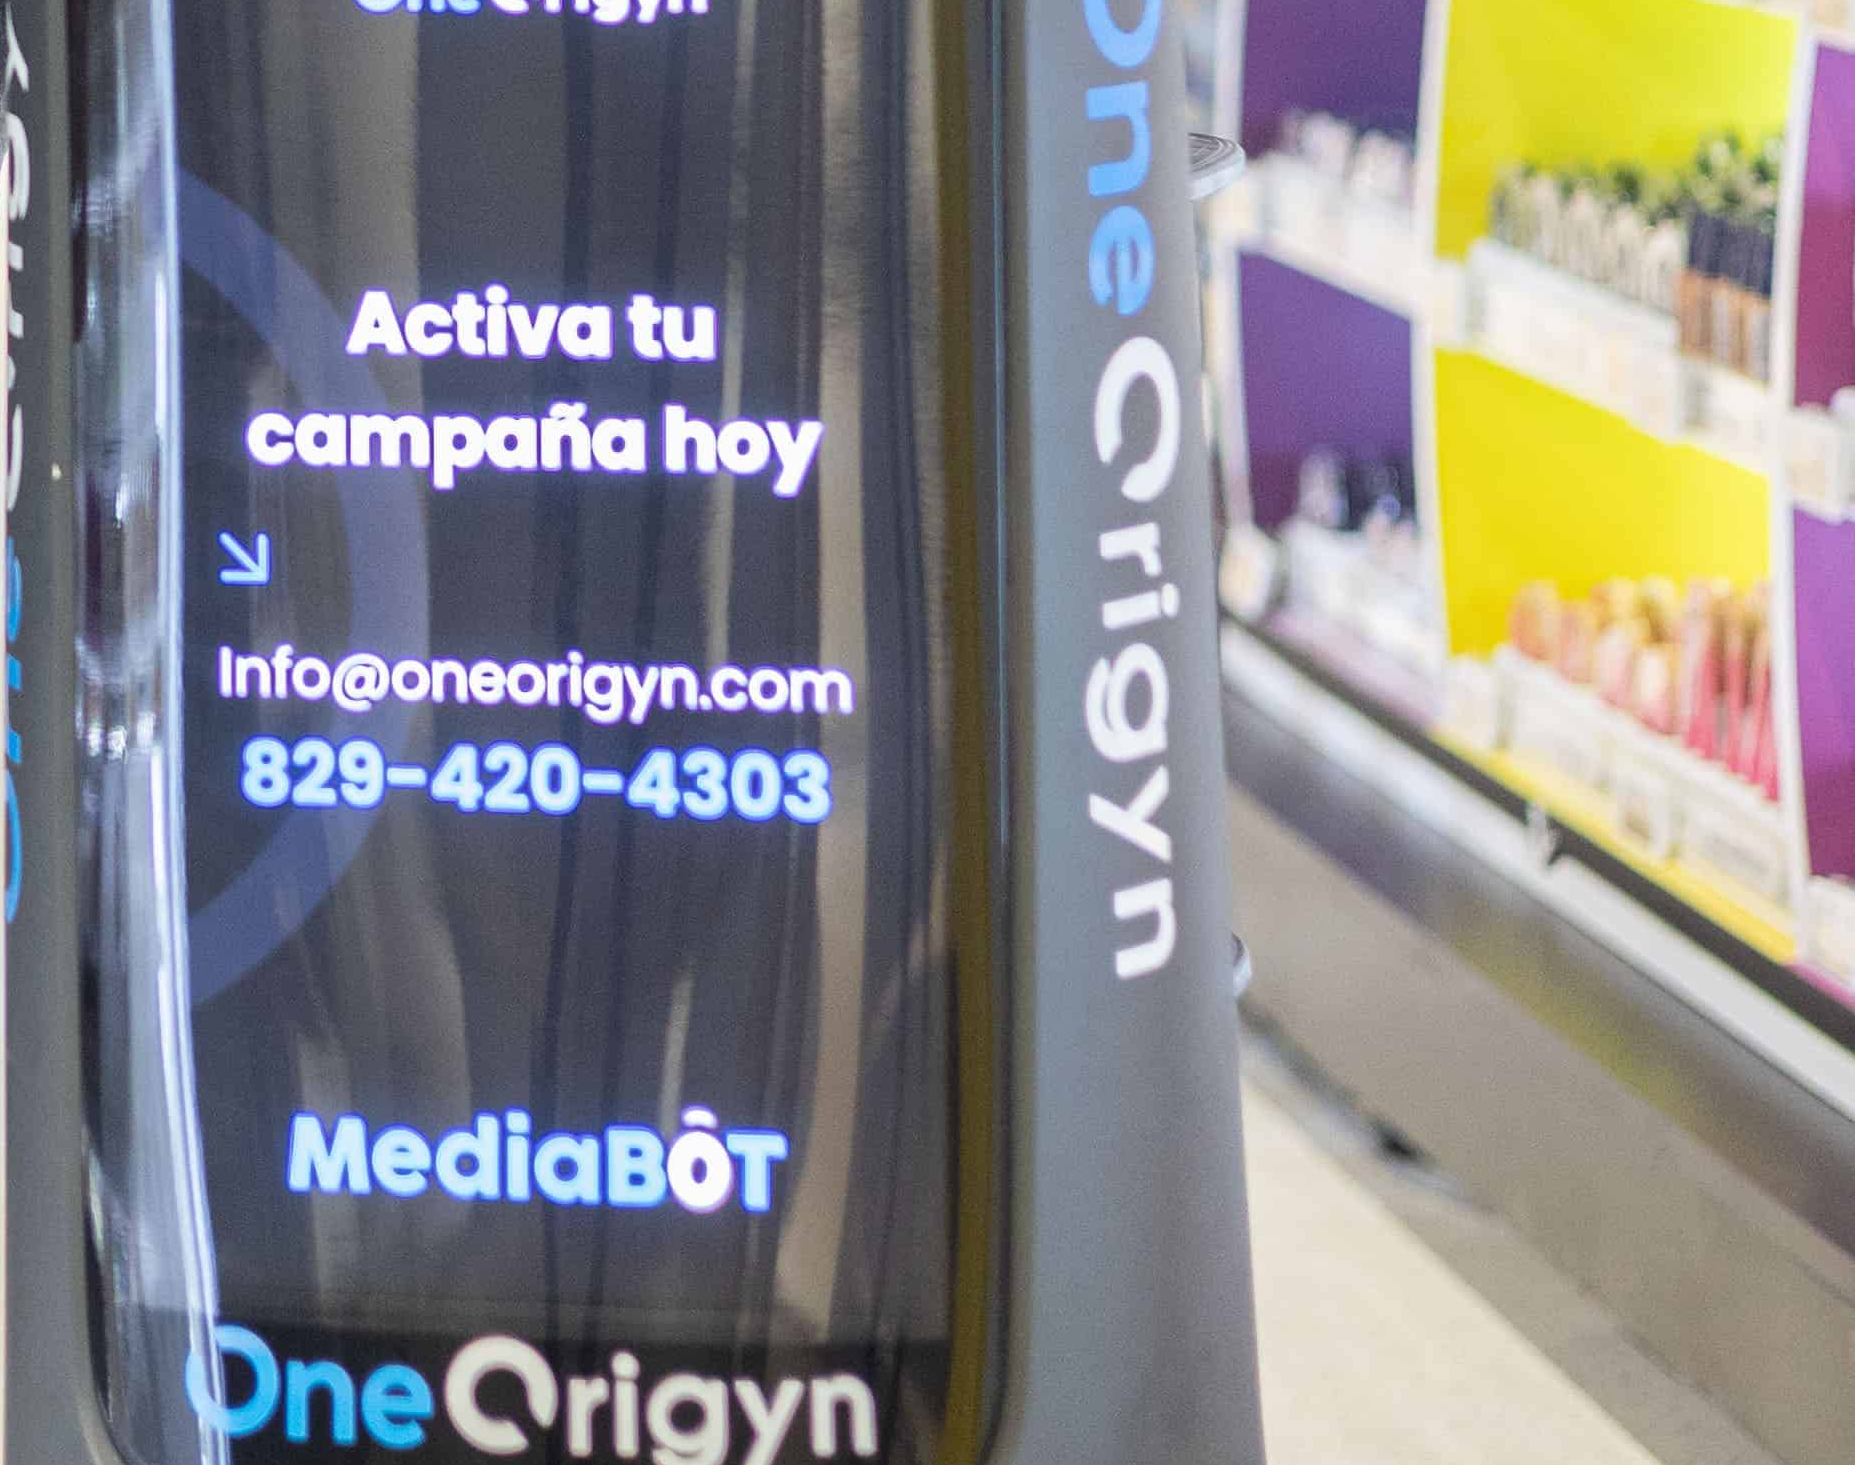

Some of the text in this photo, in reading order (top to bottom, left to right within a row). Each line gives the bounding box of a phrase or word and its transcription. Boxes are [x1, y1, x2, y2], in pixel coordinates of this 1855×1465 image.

[344, 283, 718, 362] Activa tu
[244, 400, 827, 498] campaña hoy
[217, 641, 857, 725] Info@oneorigyn.com
[238, 733, 835, 825] 829-420-4303
